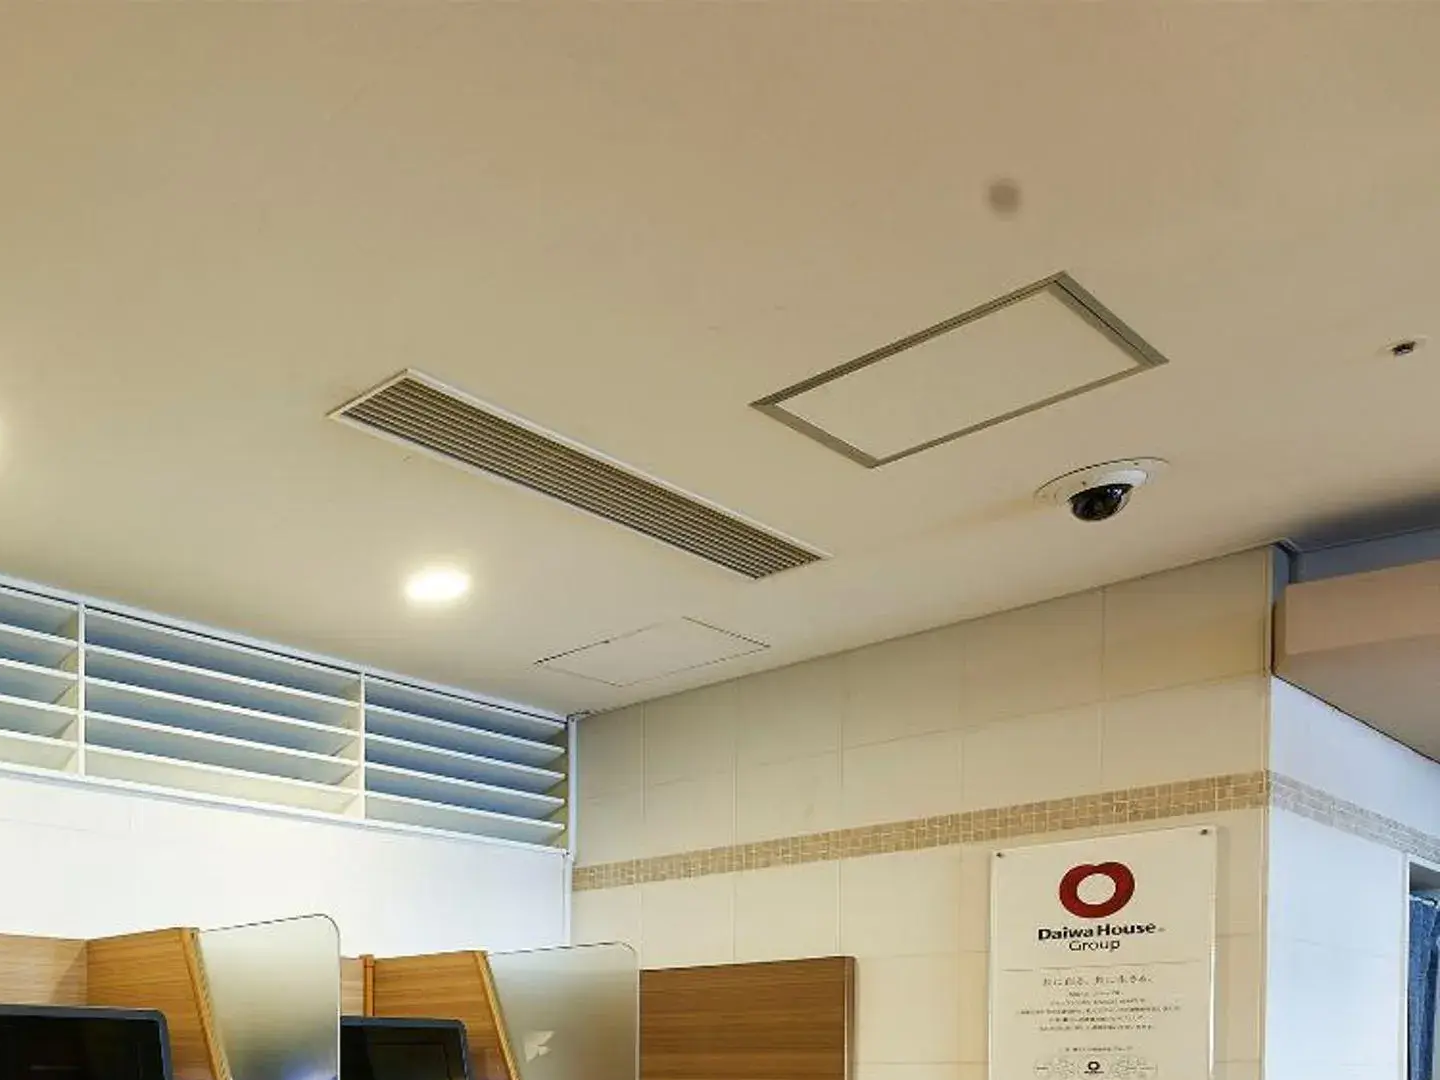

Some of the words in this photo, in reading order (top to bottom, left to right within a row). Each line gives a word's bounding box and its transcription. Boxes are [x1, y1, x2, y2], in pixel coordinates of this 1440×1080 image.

[1038, 926, 1094, 941] Daiwa
[1097, 922, 1157, 937] House
[1069, 939, 1121, 953] Group
